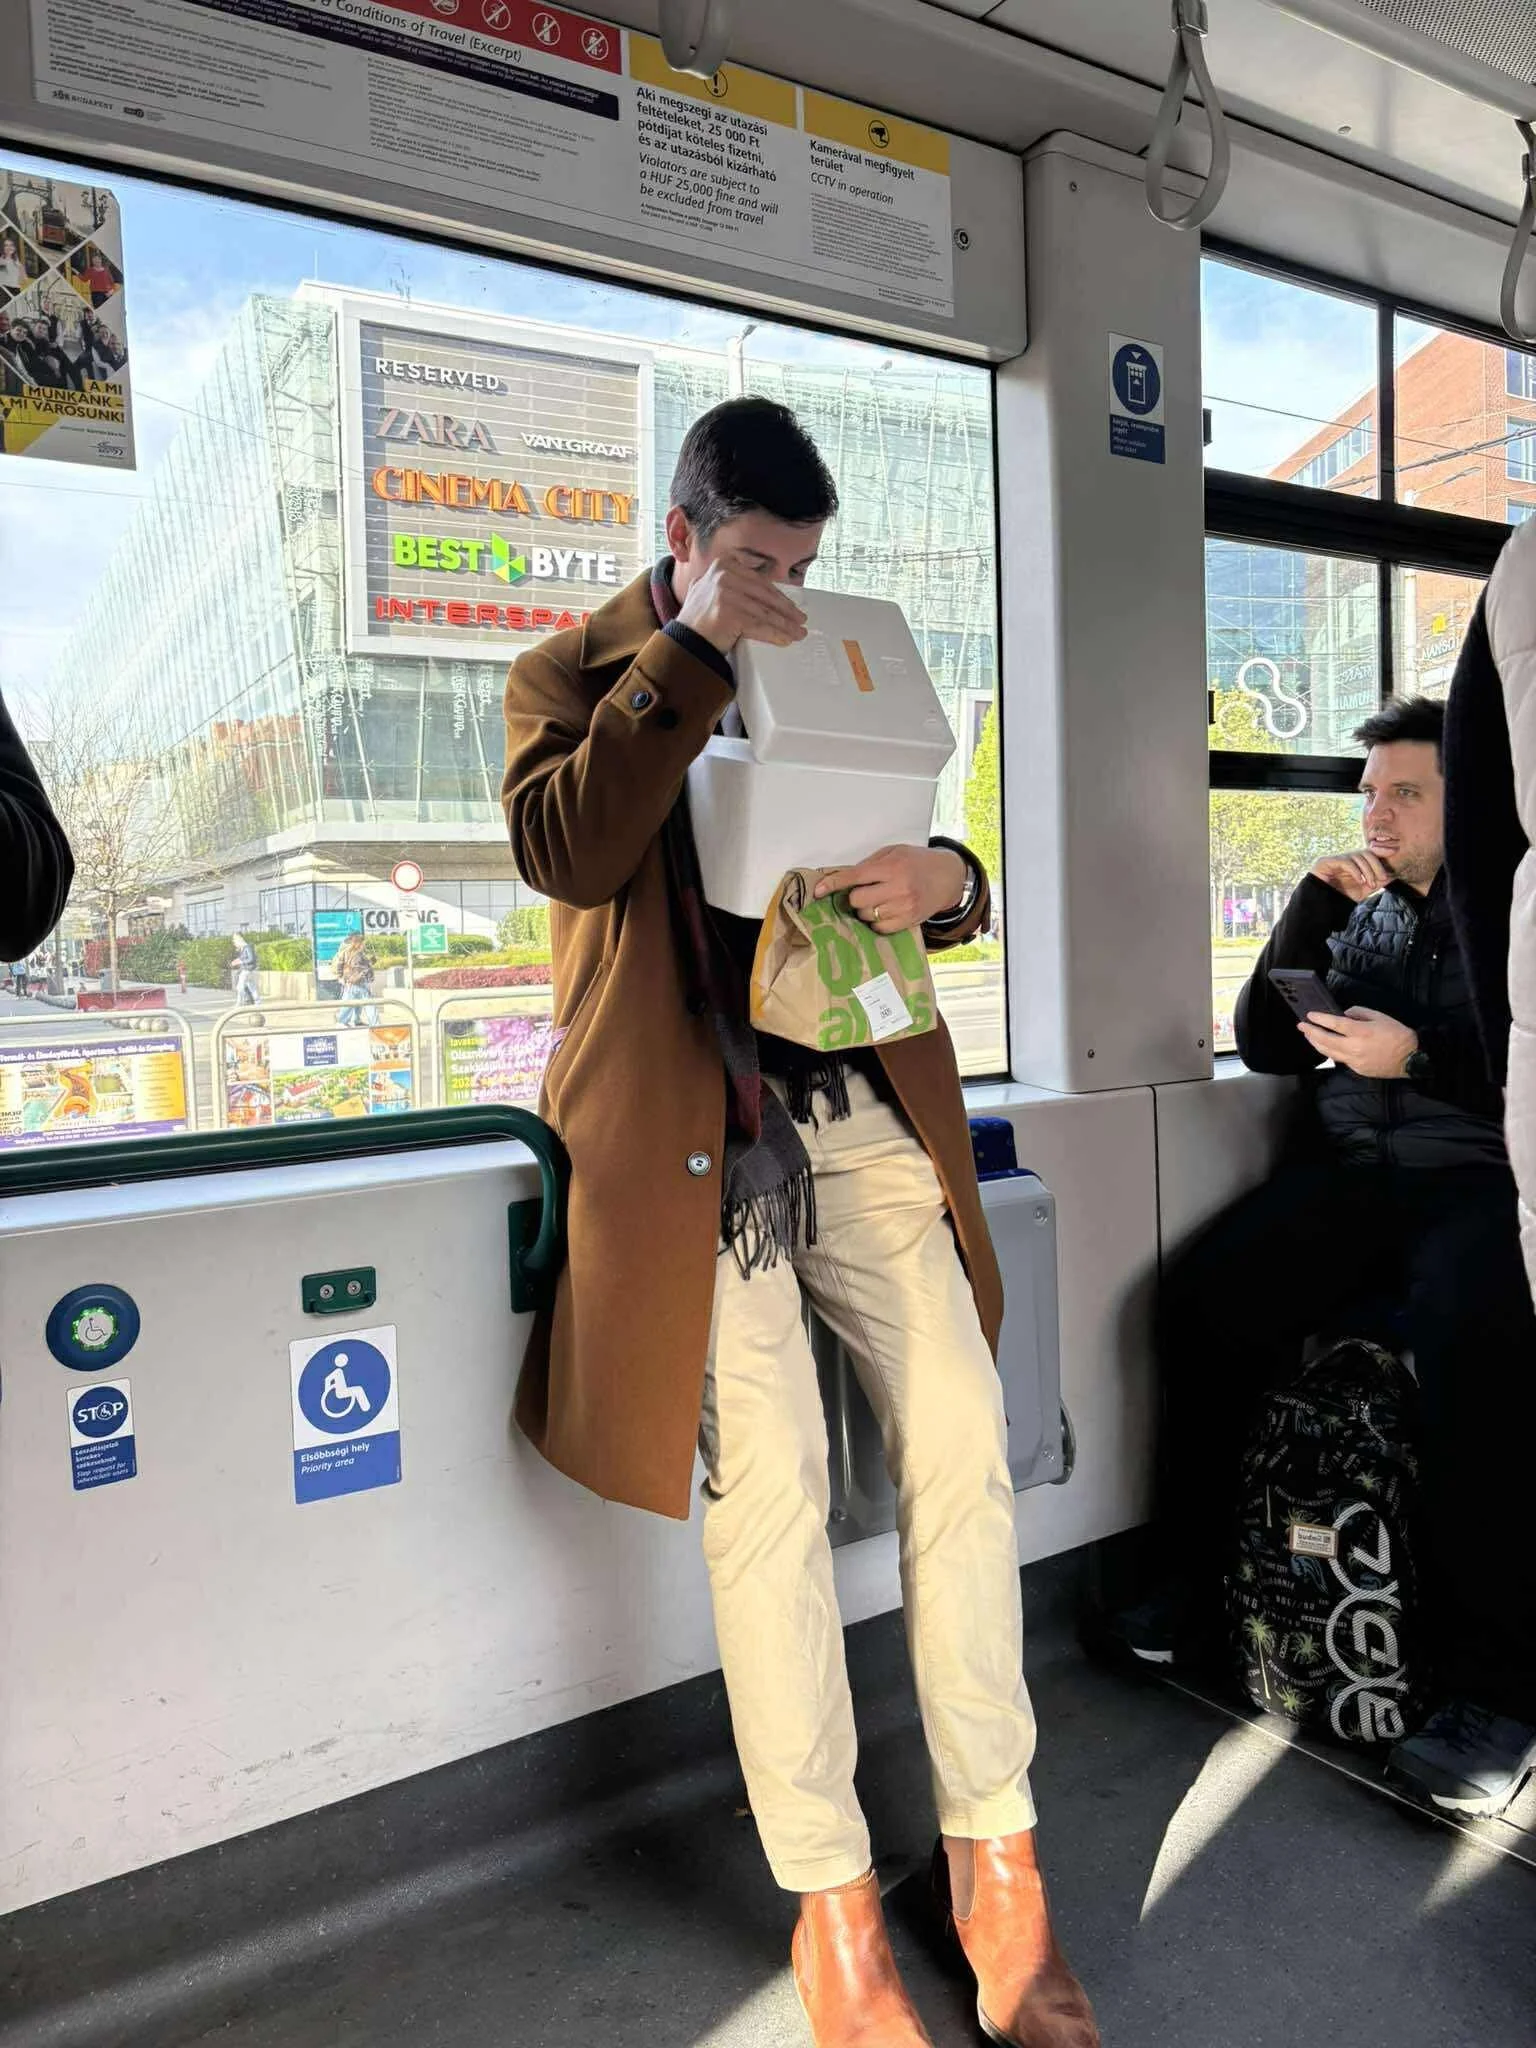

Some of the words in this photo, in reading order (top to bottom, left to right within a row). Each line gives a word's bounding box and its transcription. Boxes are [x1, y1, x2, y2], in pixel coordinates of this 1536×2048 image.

[336, 0, 407, 28] Conditions
[410, 20, 425, 36] of
[428, 24, 466, 46] Travel
[470, 36, 522, 63] (Excerpt)
[636, 88, 656, 102] Aki
[660, 94, 712, 120] megszegi
[714, 112, 728, 124] az
[730, 118, 768, 136] utazási
[637, 102, 705, 133] feltételeket,
[708, 124, 722, 137] 25
[725, 129, 746, 144] 000
[749, 135, 760, 148] Ft
[638, 119, 684, 141] pótdíjat
[686, 131, 725, 153] köteles
[728, 144, 764, 166] fizetni,
[638, 134, 650, 146] és
[654, 139, 668, 152] az
[671, 144, 724, 167] utazásból
[726, 157, 777, 182] kizárható
[810, 140, 862, 165] Kamerával
[864, 155, 916, 181] megfigyelt
[639, 152, 688, 176] Violators
[690, 168, 708, 180] are
[710, 172, 746, 193] subject
[749, 184, 760, 196] to
[810, 155, 844, 174] terület
[640, 170, 646, 178] a
[650, 170, 673, 187] HUF
[676, 178, 713, 198] 25,000
[716, 188, 736, 204] fine
[738, 196, 758, 210] and
[761, 201, 779, 215] will
[640, 184, 654, 197] be
[657, 190, 704, 210] excluded
[707, 201, 733, 218] from
[735, 208, 764, 225] travel
[810, 172, 836, 187] CCTV
[838, 180, 847, 192] in
[849, 182, 894, 206] operation
[90, 382, 100, 392] A
[105, 383, 122, 395] MI
[374, 357, 500, 390] RESERVED
[376, 408, 496, 451] ZARA
[372, 465, 531, 514] CINEMA
[543, 484, 635, 525] CITY
[393, 534, 484, 572] BEST
[532, 548, 617, 584] BYTE
[301, 1445, 349, 1463] Elsőbbségi
[352, 1443, 370, 1454] hely
[301, 1462, 333, 1475] Priority
[335, 1458, 355, 1468] area
